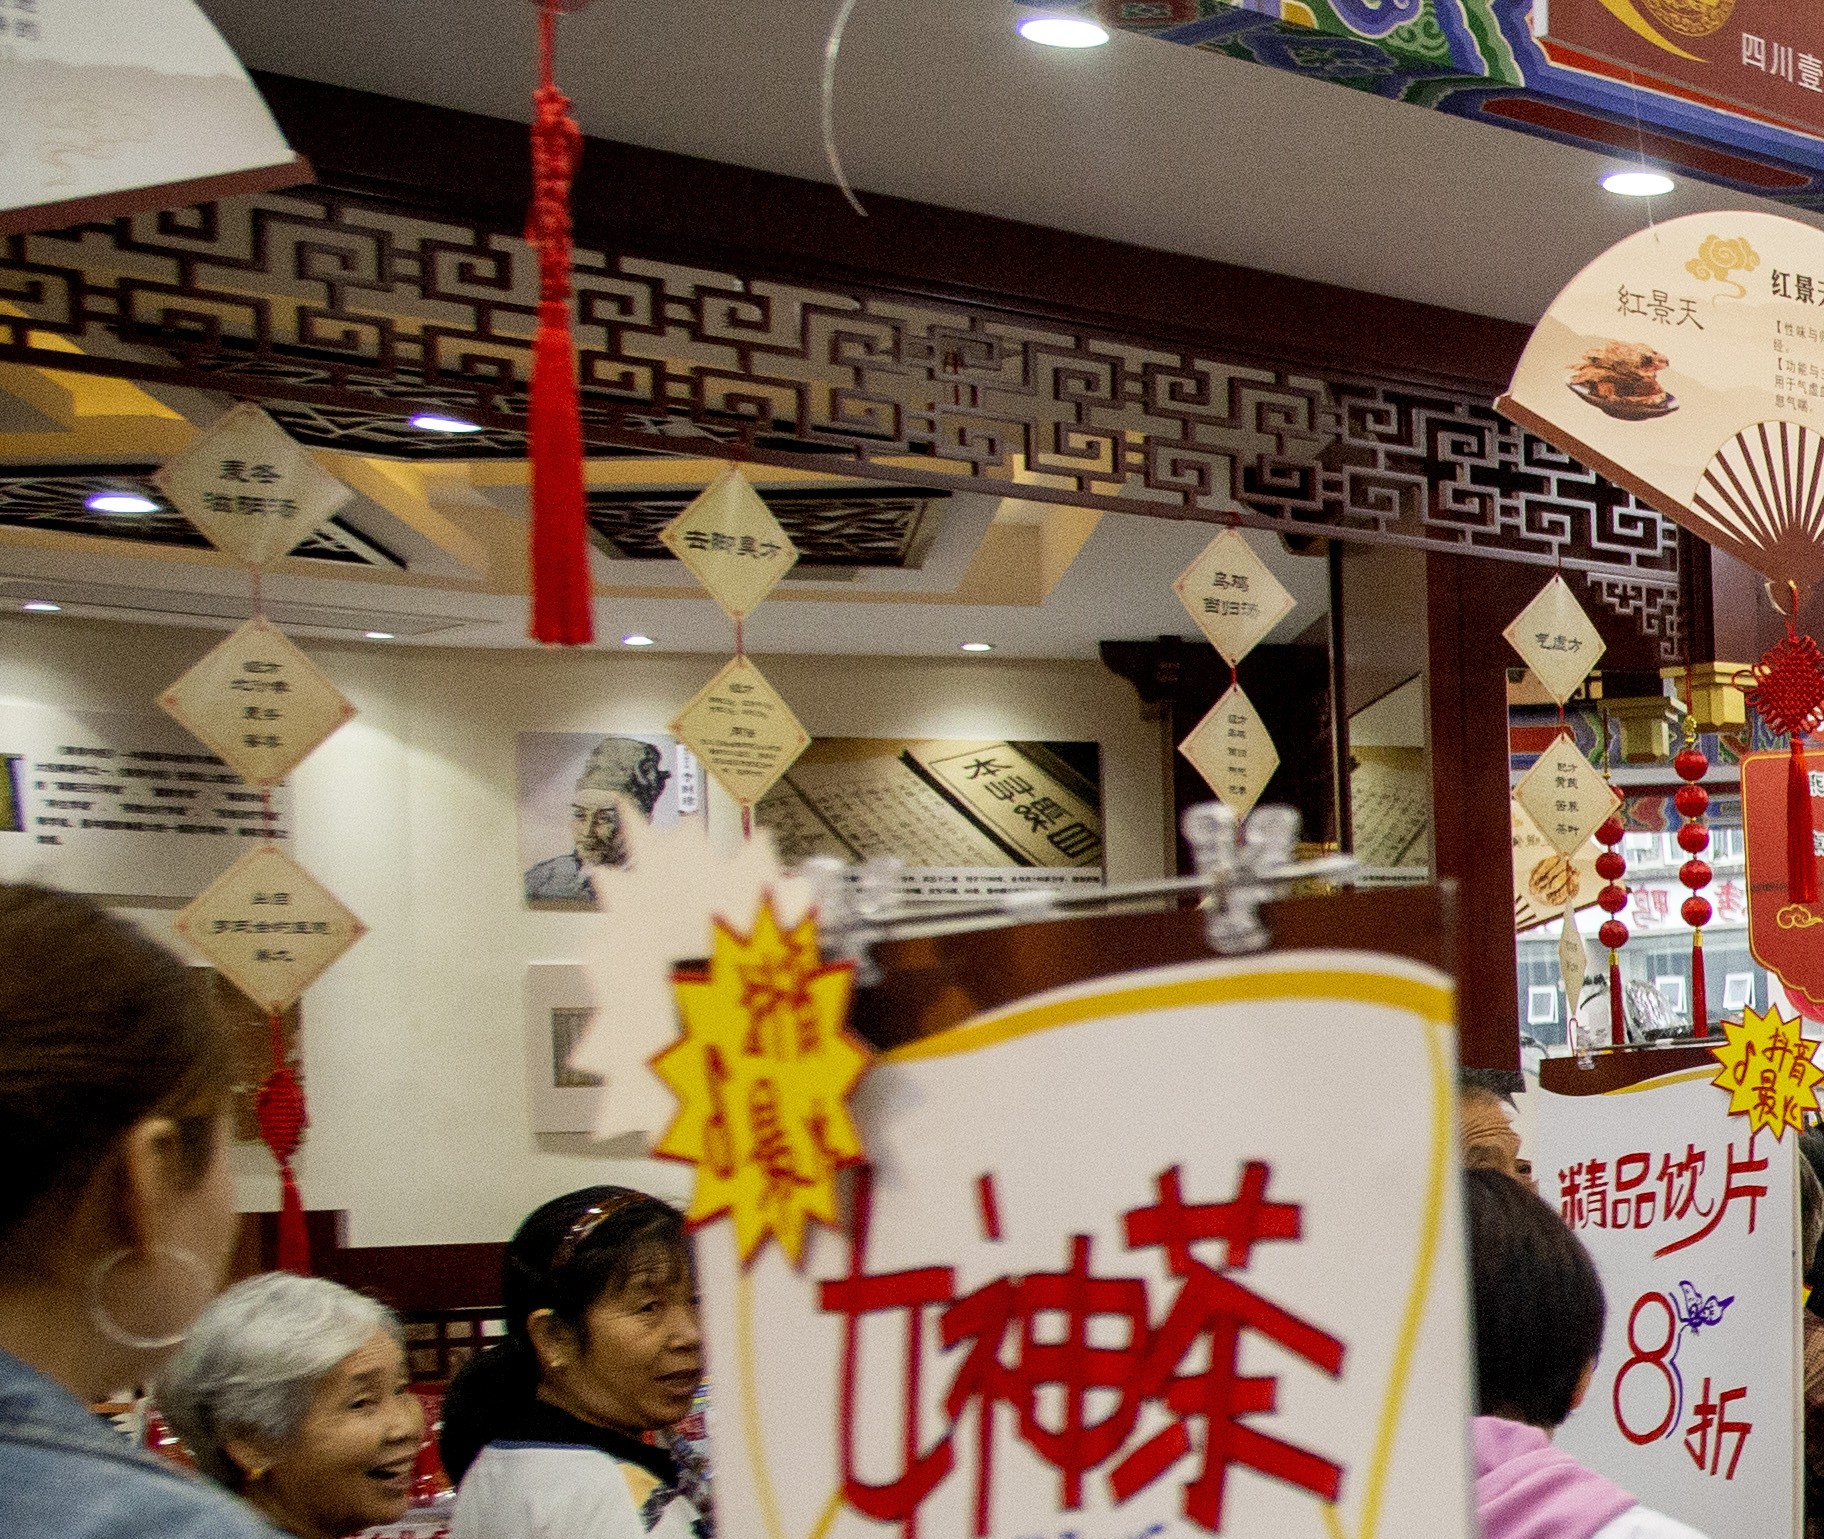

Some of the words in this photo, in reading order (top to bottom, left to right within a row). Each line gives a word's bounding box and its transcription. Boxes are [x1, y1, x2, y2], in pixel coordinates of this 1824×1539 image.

[1767, 1026, 1808, 1090] 抖音
[1752, 1069, 1801, 1130] 最火
[1558, 1134, 1768, 1259] 精品饮片
